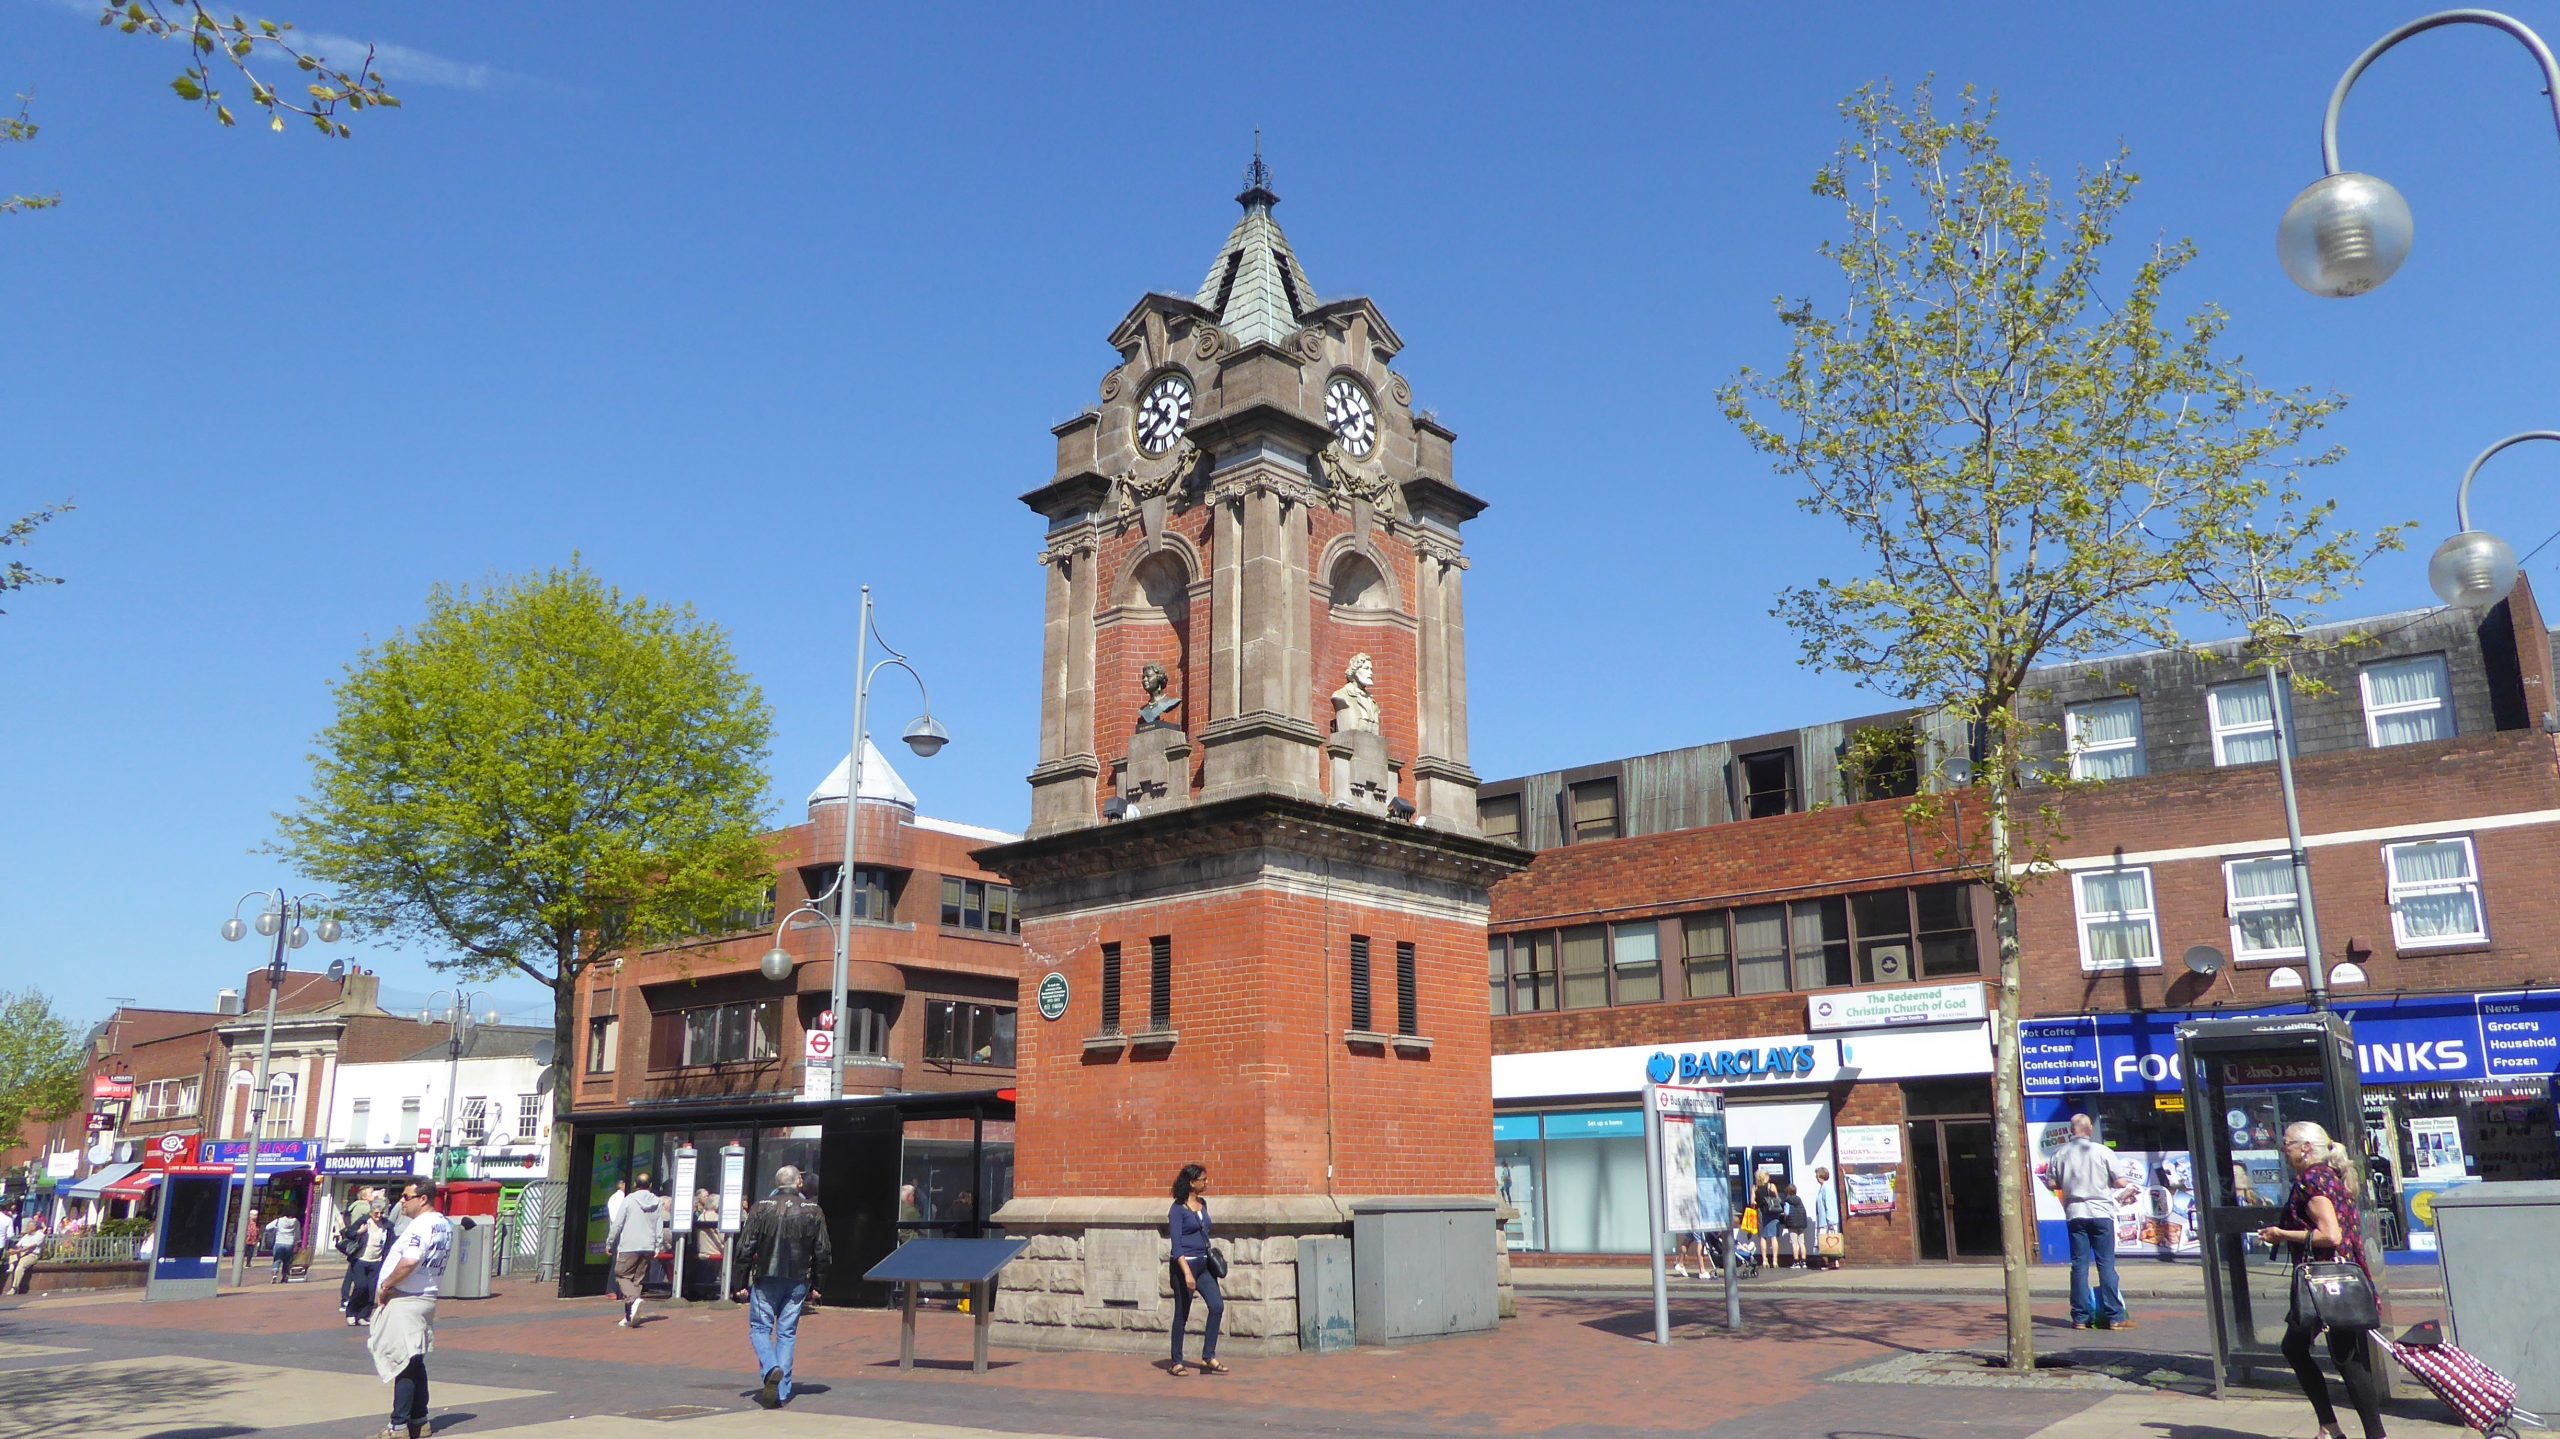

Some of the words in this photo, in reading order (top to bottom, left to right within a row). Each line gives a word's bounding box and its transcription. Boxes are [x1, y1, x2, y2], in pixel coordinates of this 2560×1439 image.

[1867, 994, 1886, 1005] The
[1888, 989, 1942, 1003] Redeemed
[1846, 1004, 1891, 1018] Christian
[1893, 1001, 1929, 1014] Church
[1932, 1000, 1943, 1010] of
[1944, 998, 1967, 1010] God
[2484, 1004, 2520, 1014] News
[822, 1012, 833, 1025] M
[2487, 1021, 2539, 1033] Grocery
[2020, 1029, 2040, 1039] Hot
[2042, 1028, 2077, 1037] Coffee
[2022, 1045, 2038, 1054] Ice
[2040, 1044, 2074, 1053] Cream
[2490, 1037, 2557, 1050] Household
[1680, 1044, 1816, 1079] BARCLAYS
[2357, 1039, 2468, 1074] INKS
[2492, 1057, 2539, 1067] Frozen
[2024, 1059, 2098, 1070] Confectionary
[2025, 1076, 2061, 1086] Chilled
[2063, 1074, 2099, 1085] Drinks
[1670, 1094, 1681, 1106] Bus
[1681, 1095, 1714, 1109] information
[1608, 1119, 1623, 1127] home
[325, 1156, 377, 1169] BROADWAY
[376, 1155, 404, 1168] NEWS
